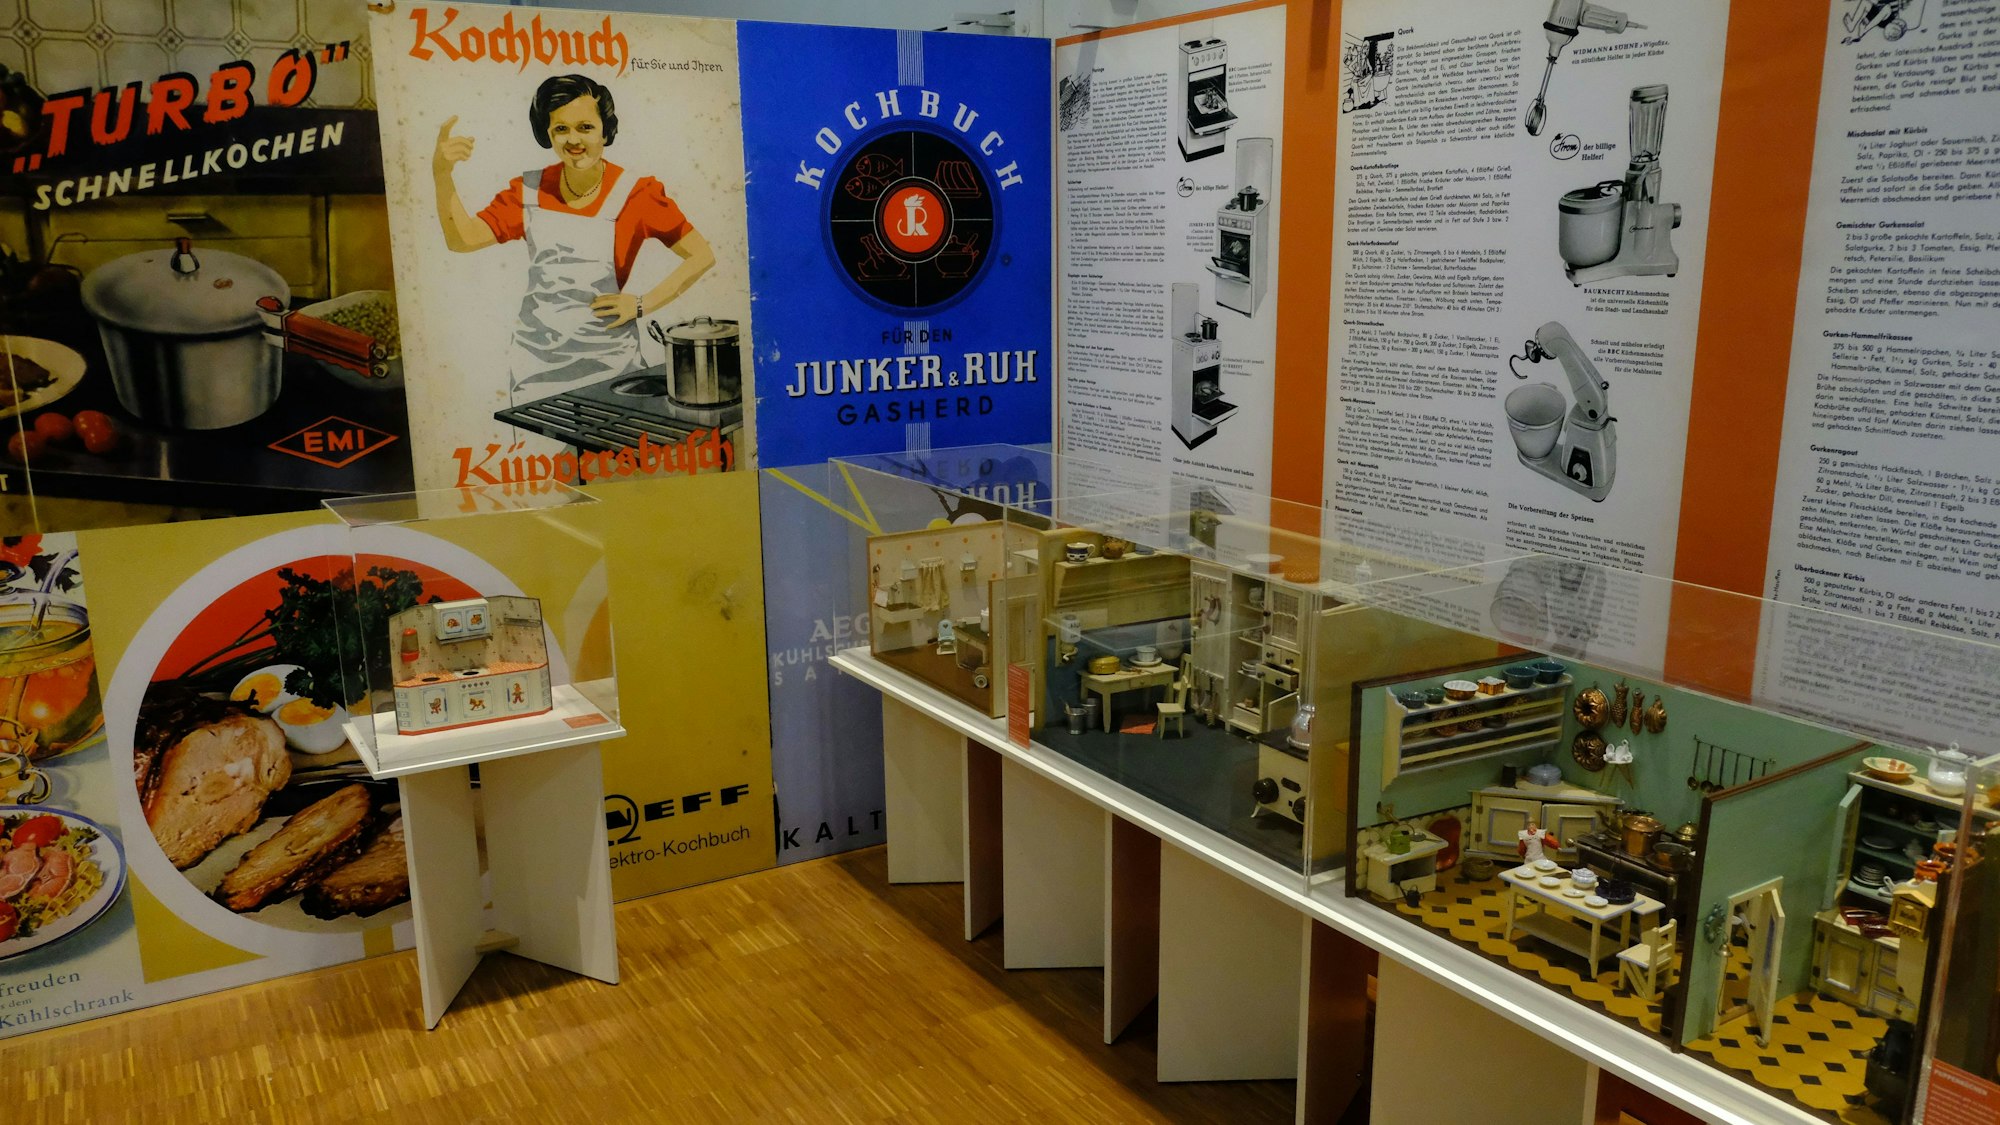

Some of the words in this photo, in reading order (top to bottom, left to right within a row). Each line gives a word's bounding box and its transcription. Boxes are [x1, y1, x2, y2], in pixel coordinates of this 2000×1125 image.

[409, 8, 628, 80] Kochbuch
[669, 60, 689, 70] und
[795, 89, 1023, 190] KOCHBUCH
[1847, 130, 1886, 138] Mischsalat
[33, 121, 346, 211] SCHNELLKOCHEN
[1836, 221, 1875, 229] Gemischter
[1879, 221, 1925, 229] Gurkensalat
[882, 328, 913, 344] FÜR
[919, 329, 952, 343] DEN
[1823, 330, 1913, 341] Gurken-Hammelfrikassee
[786, 355, 943, 397] JUNKER
[948, 371, 960, 387] &
[963, 350, 1037, 385] RUH
[837, 395, 994, 426] GASHERD
[304, 427, 364, 453] EMI
[1810, 444, 1858, 456] Gurkenragout
[1520, 504, 1556, 518] Vorbereitung
[1571, 514, 1594, 523] Speisen
[1843, 573, 1865, 582] Kürbis
[783, 810, 882, 850] KALT
[610, 824, 750, 869] ektro-Kochbuch
[0, 989, 134, 1029] Kühlschrank
